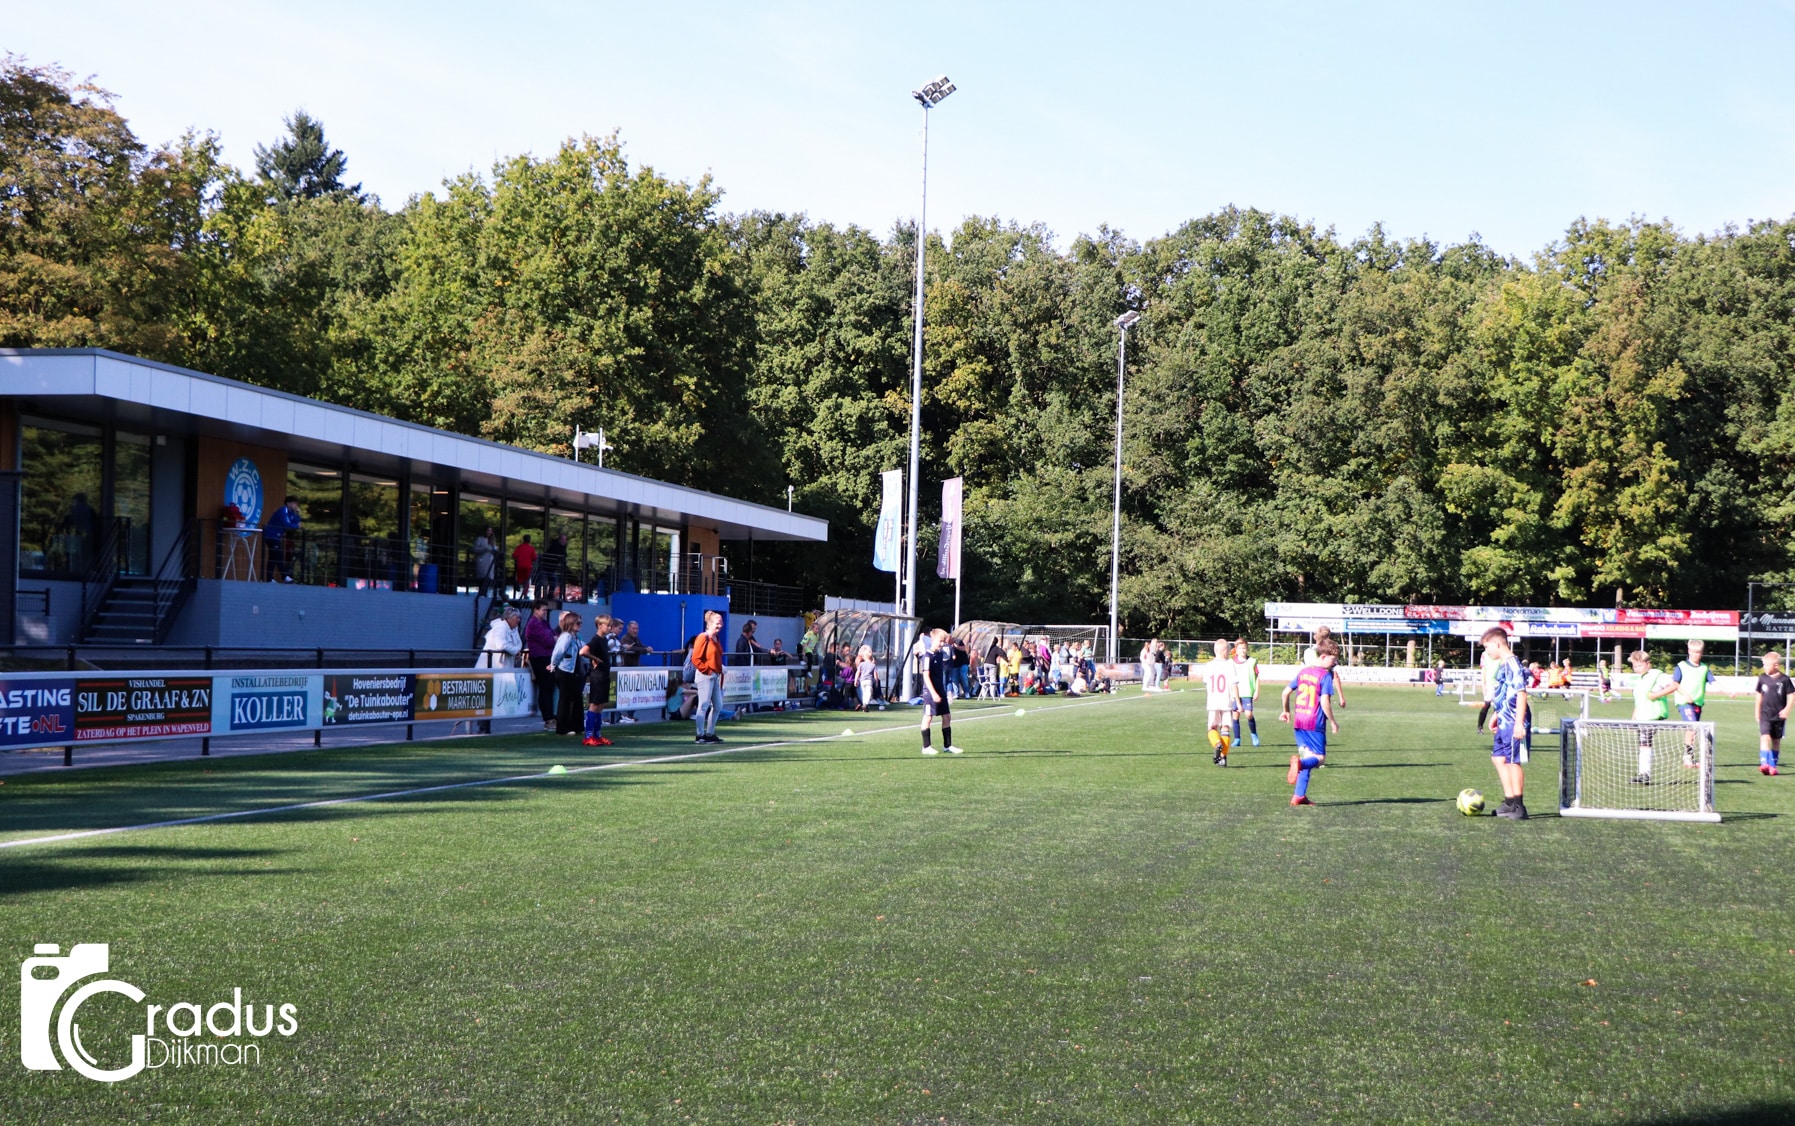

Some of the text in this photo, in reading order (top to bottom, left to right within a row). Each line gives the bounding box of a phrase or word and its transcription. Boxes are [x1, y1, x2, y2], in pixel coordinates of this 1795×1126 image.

[1529, 623, 1577, 635] Rabobank
[128, 679, 166, 688] VISHANDEL
[231, 676, 309, 689] INSTALLATIEBEDRIJF
[352, 676, 407, 691] Hoveniersbedrijf
[442, 680, 486, 694] BESTRATINGS
[618, 674, 667, 692] KRUIZINGA.NL
[1209, 674, 1226, 693] 10
[77, 692, 102, 713] SIL
[106, 691, 127, 711] DE
[131, 689, 180, 710] GRAAF
[360, 693, 414, 708] Tuinkabouter"
[448, 695, 486, 709] MARKT.COM
[1295, 682, 1316, 708] 21
[126, 712, 165, 722] SPAKENBURG
[233, 695, 305, 724] KOLLER
[348, 709, 409, 721] detuinkabouter-epe.nl
[77, 722, 209, 739] ZATERDAG OP HET PLEIN IN WAPENVELD
